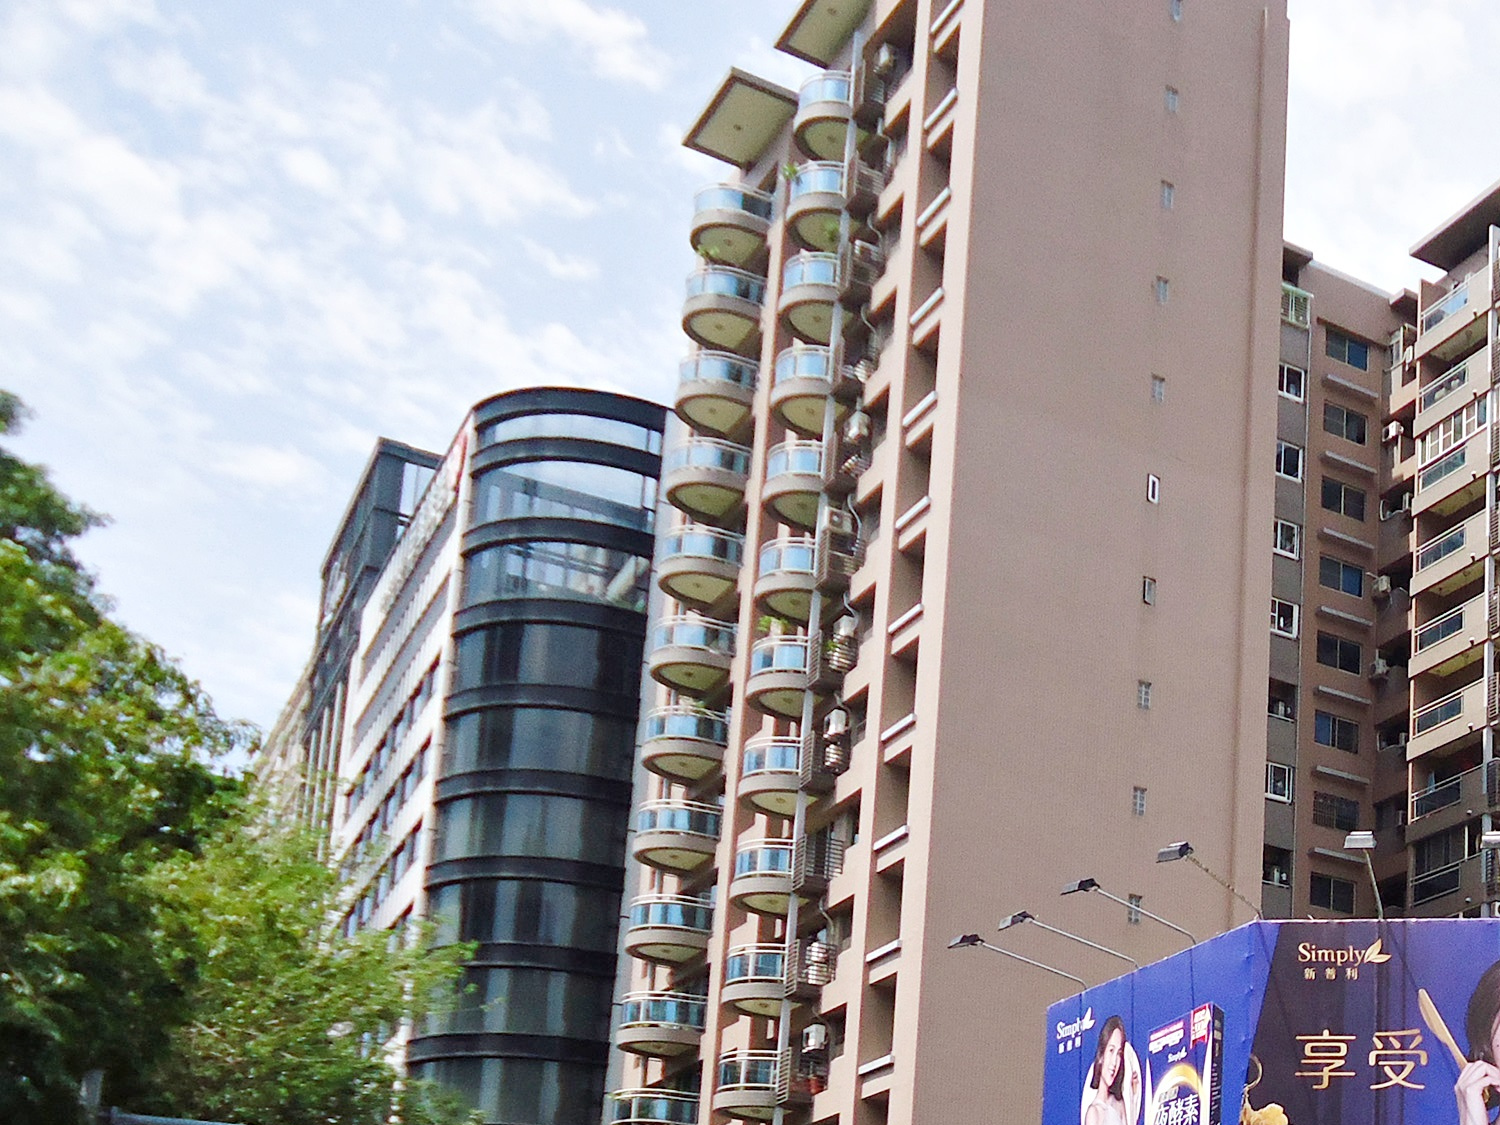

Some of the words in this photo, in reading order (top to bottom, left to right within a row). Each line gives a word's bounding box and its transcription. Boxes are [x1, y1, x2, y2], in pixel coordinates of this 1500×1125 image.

[1298, 942, 1366, 967] Simply
[1304, 967, 1358, 980] 新普利
[1295, 1029, 1428, 1089] 享受
